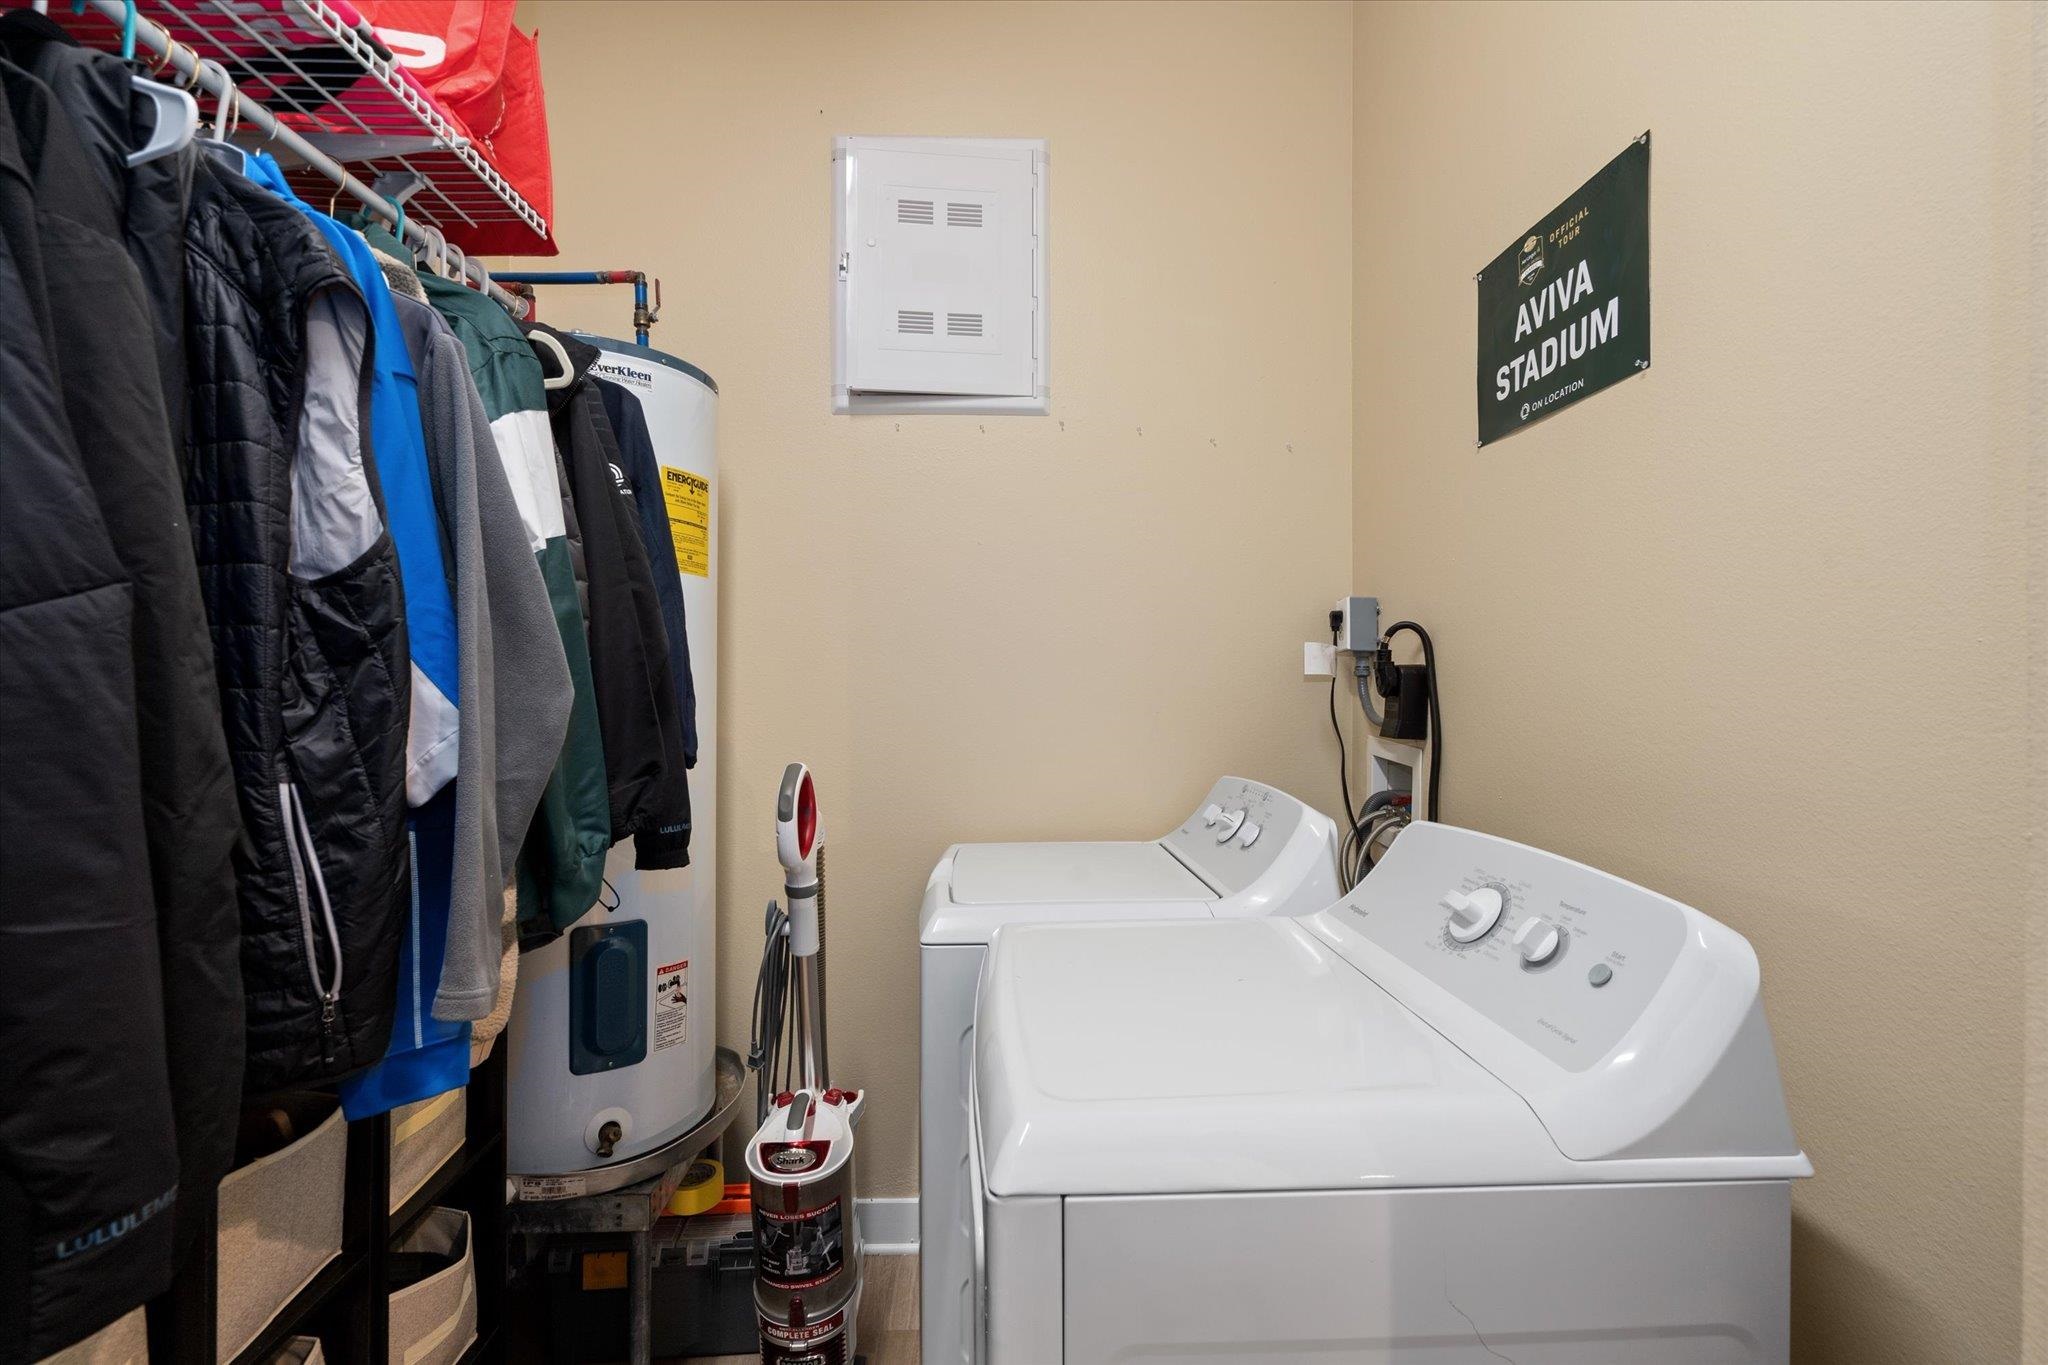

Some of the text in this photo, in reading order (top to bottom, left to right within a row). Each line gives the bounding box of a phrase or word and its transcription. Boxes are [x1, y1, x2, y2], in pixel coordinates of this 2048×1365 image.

[1549, 206, 1590, 243] OFFICIAL
[1558, 225, 1581, 249] TOUR
[1514, 259, 1594, 343] AVIVA
[1495, 296, 1619, 401] STADIUM
[1531, 378, 1585, 412] ON LOCATION
[776, 1156, 805, 1166] Shark
[806, 1200, 838, 1218] SUCTION
[767, 1322, 834, 1340] COMPLETE SEAL
